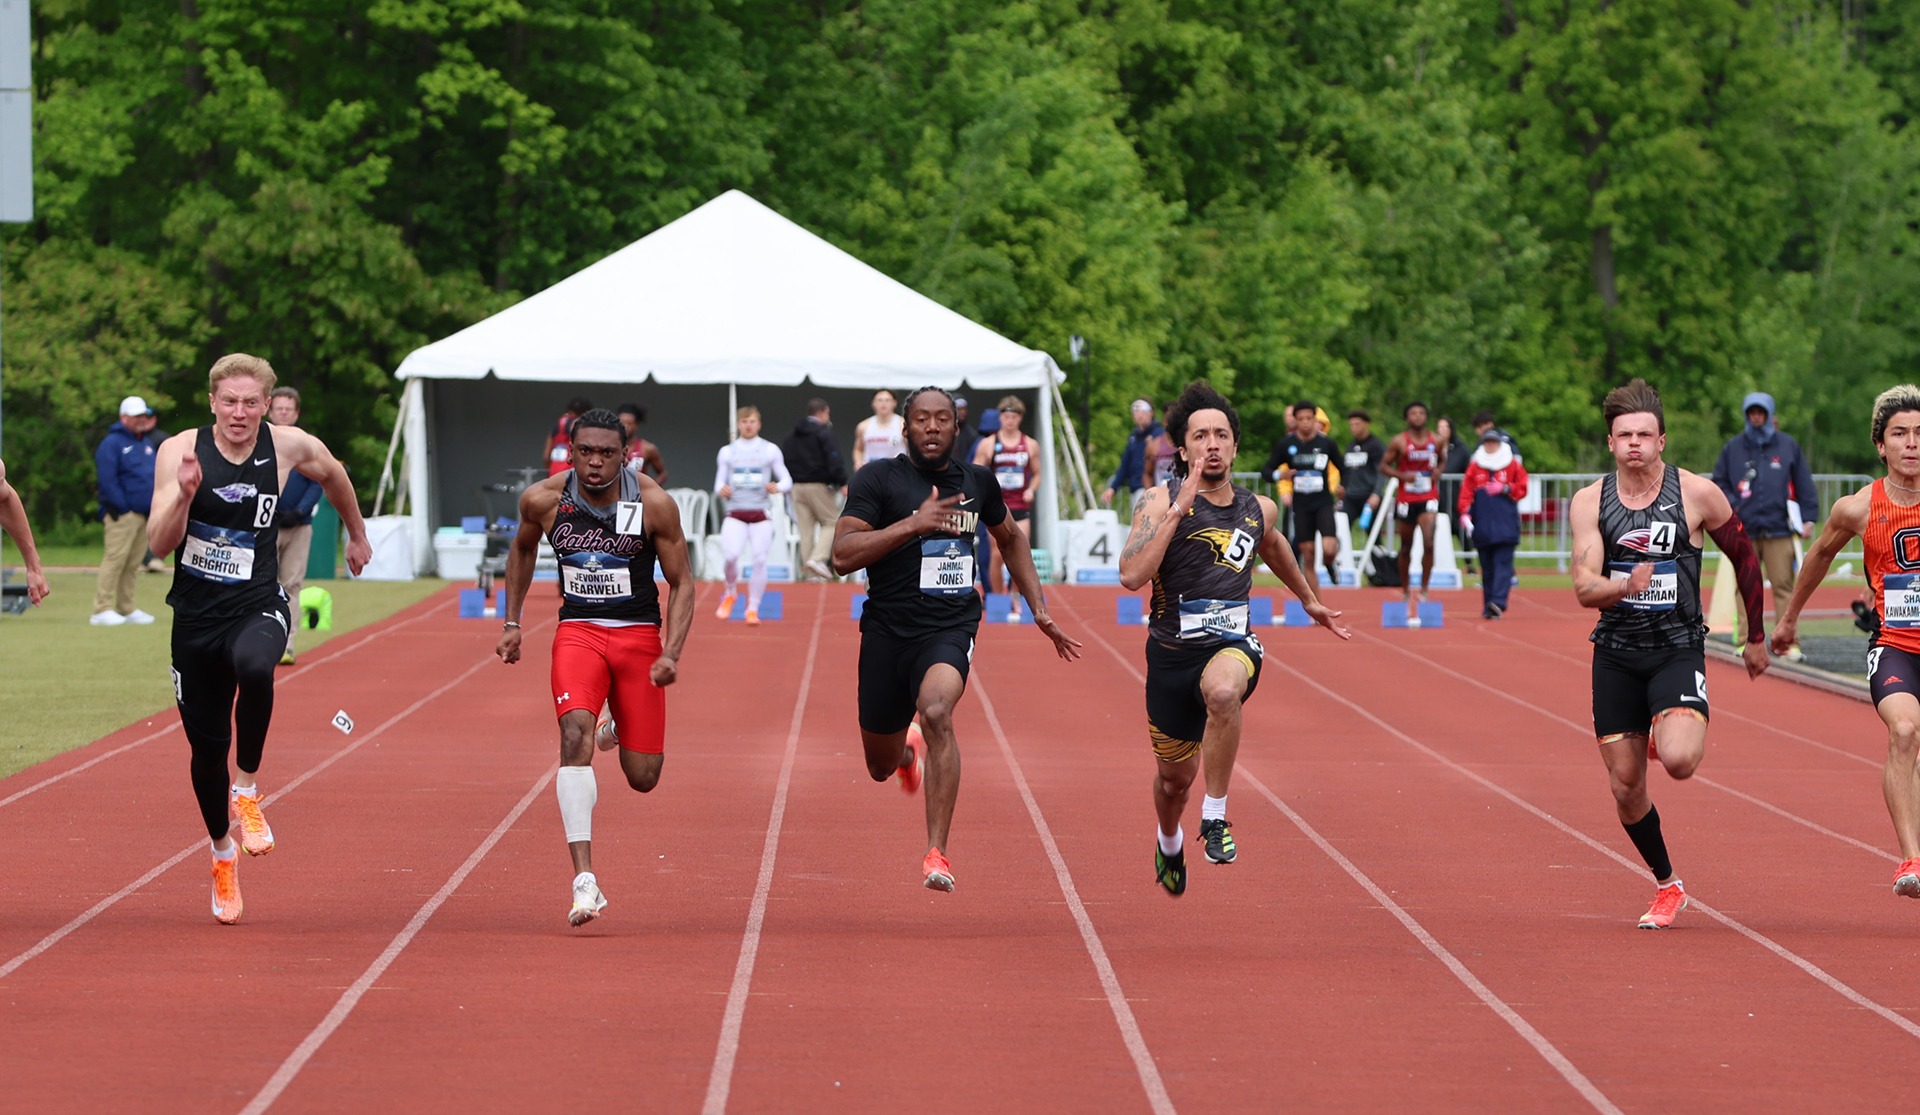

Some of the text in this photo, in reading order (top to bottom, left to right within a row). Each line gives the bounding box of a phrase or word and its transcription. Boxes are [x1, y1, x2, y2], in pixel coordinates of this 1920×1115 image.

[260, 497, 273, 526] 8
[623, 504, 637, 532] 7
[1229, 533, 1250, 562] 5
[1652, 525, 1671, 552] 4
[205, 546, 231, 560] CALEB
[1088, 533, 1112, 564] 4
[191, 554, 241, 576] BEIGHTOL
[937, 561, 963, 571] JAHMAL
[574, 572, 615, 583] JEVONTAE
[936, 572, 964, 586] JONES
[570, 581, 623, 596] FEARWELL
[1201, 614, 1231, 627] DAVIAN
